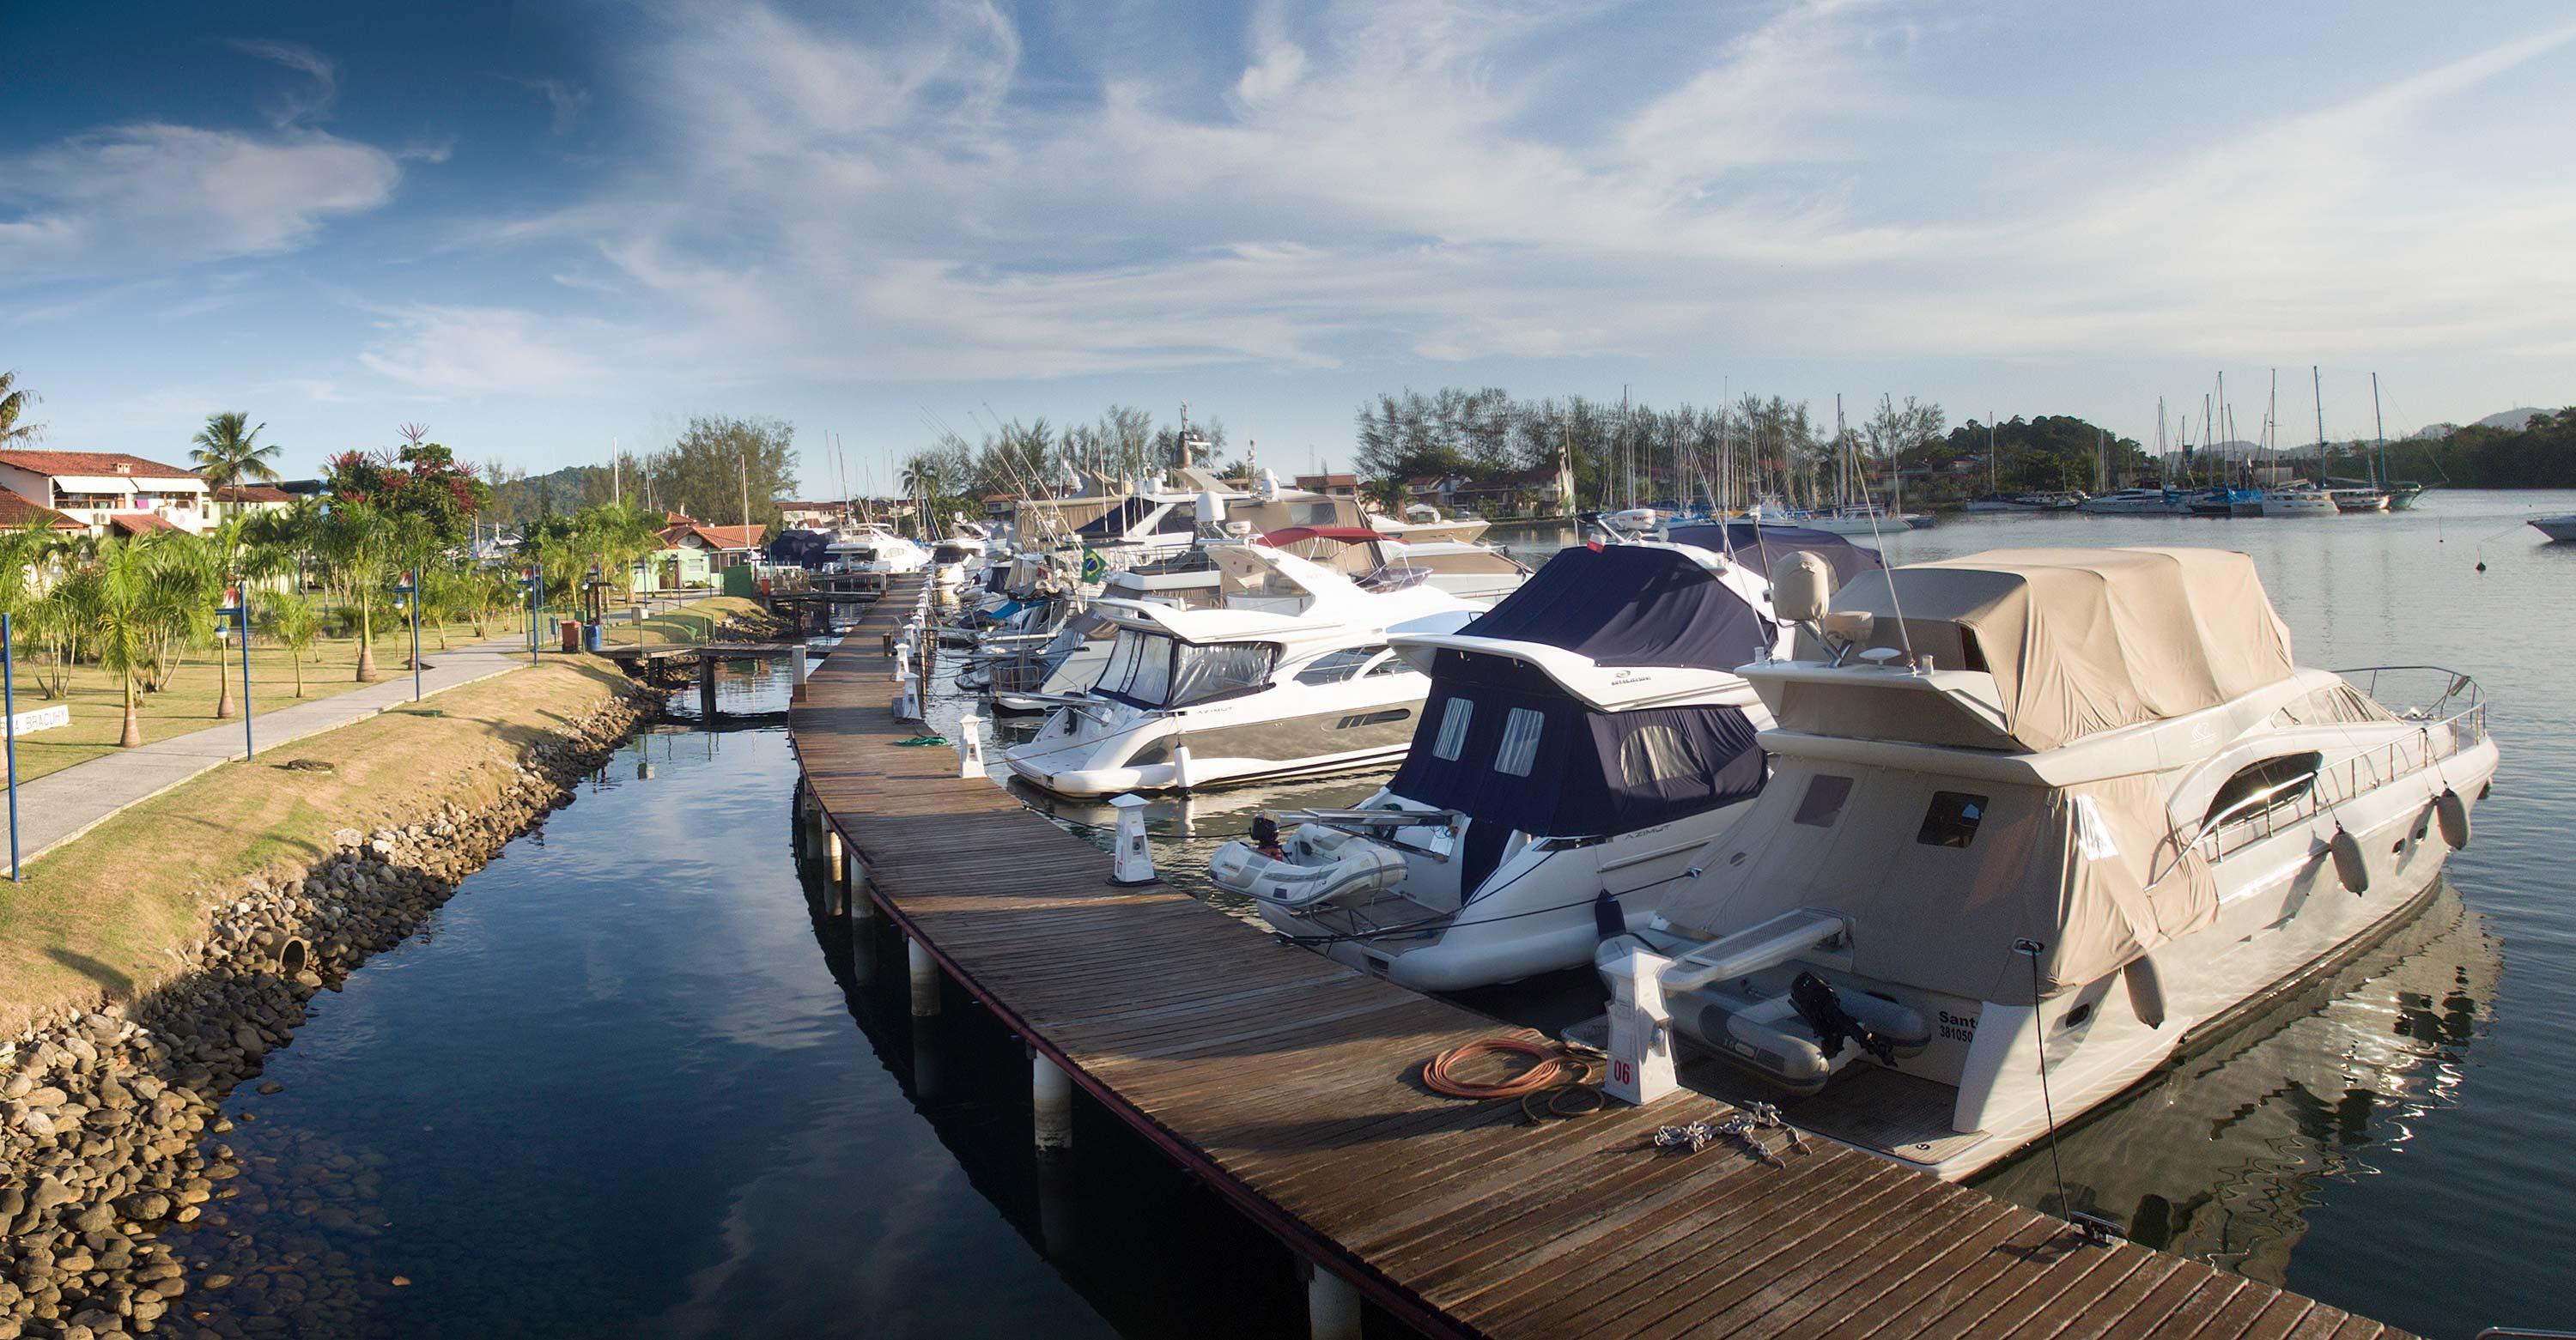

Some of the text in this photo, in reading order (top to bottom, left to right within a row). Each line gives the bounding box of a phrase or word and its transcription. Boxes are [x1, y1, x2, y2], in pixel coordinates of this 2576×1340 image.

[1624, 823, 1671, 840] AZIMUT
[1939, 1010, 1978, 1029] Sant
[1614, 1058, 1631, 1086] 06
